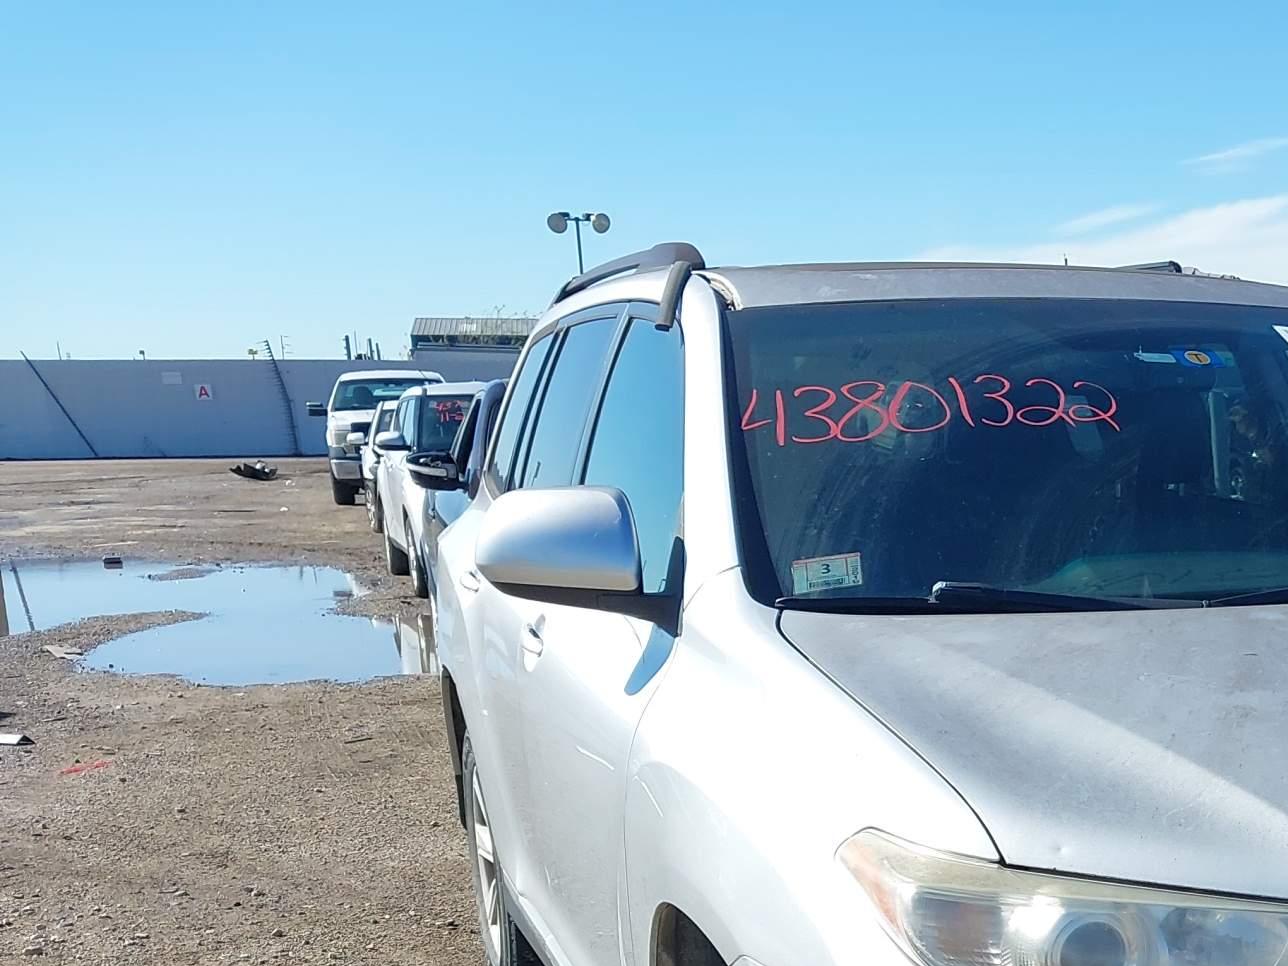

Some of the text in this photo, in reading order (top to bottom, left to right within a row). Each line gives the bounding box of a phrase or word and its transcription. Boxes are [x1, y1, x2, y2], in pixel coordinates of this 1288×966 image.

[198, 384, 210, 398] A
[739, 374, 1122, 447] 43801322
[821, 563, 831, 574] 3
